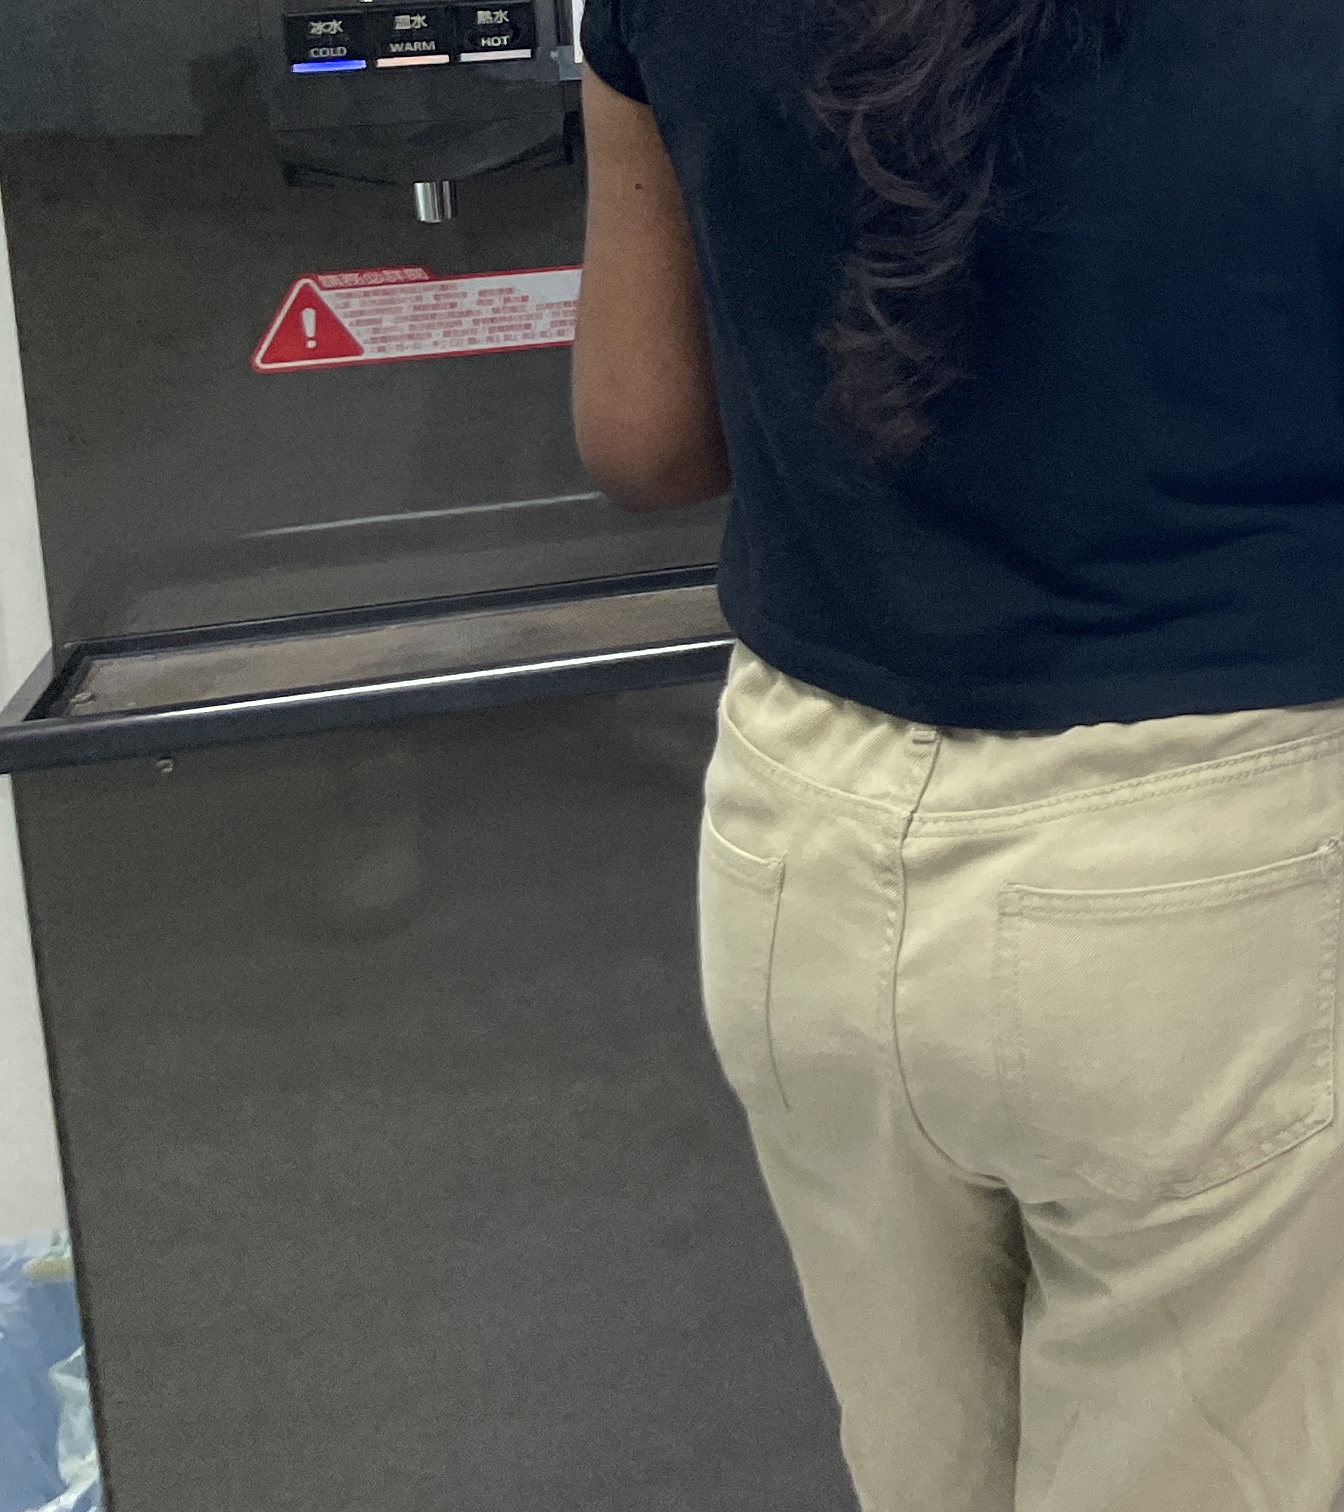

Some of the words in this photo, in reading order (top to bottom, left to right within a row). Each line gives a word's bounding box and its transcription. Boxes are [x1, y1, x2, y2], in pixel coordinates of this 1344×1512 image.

[389, 40, 437, 53] WARM
[481, 35, 510, 47] HOT
[309, 46, 347, 59] COLD
